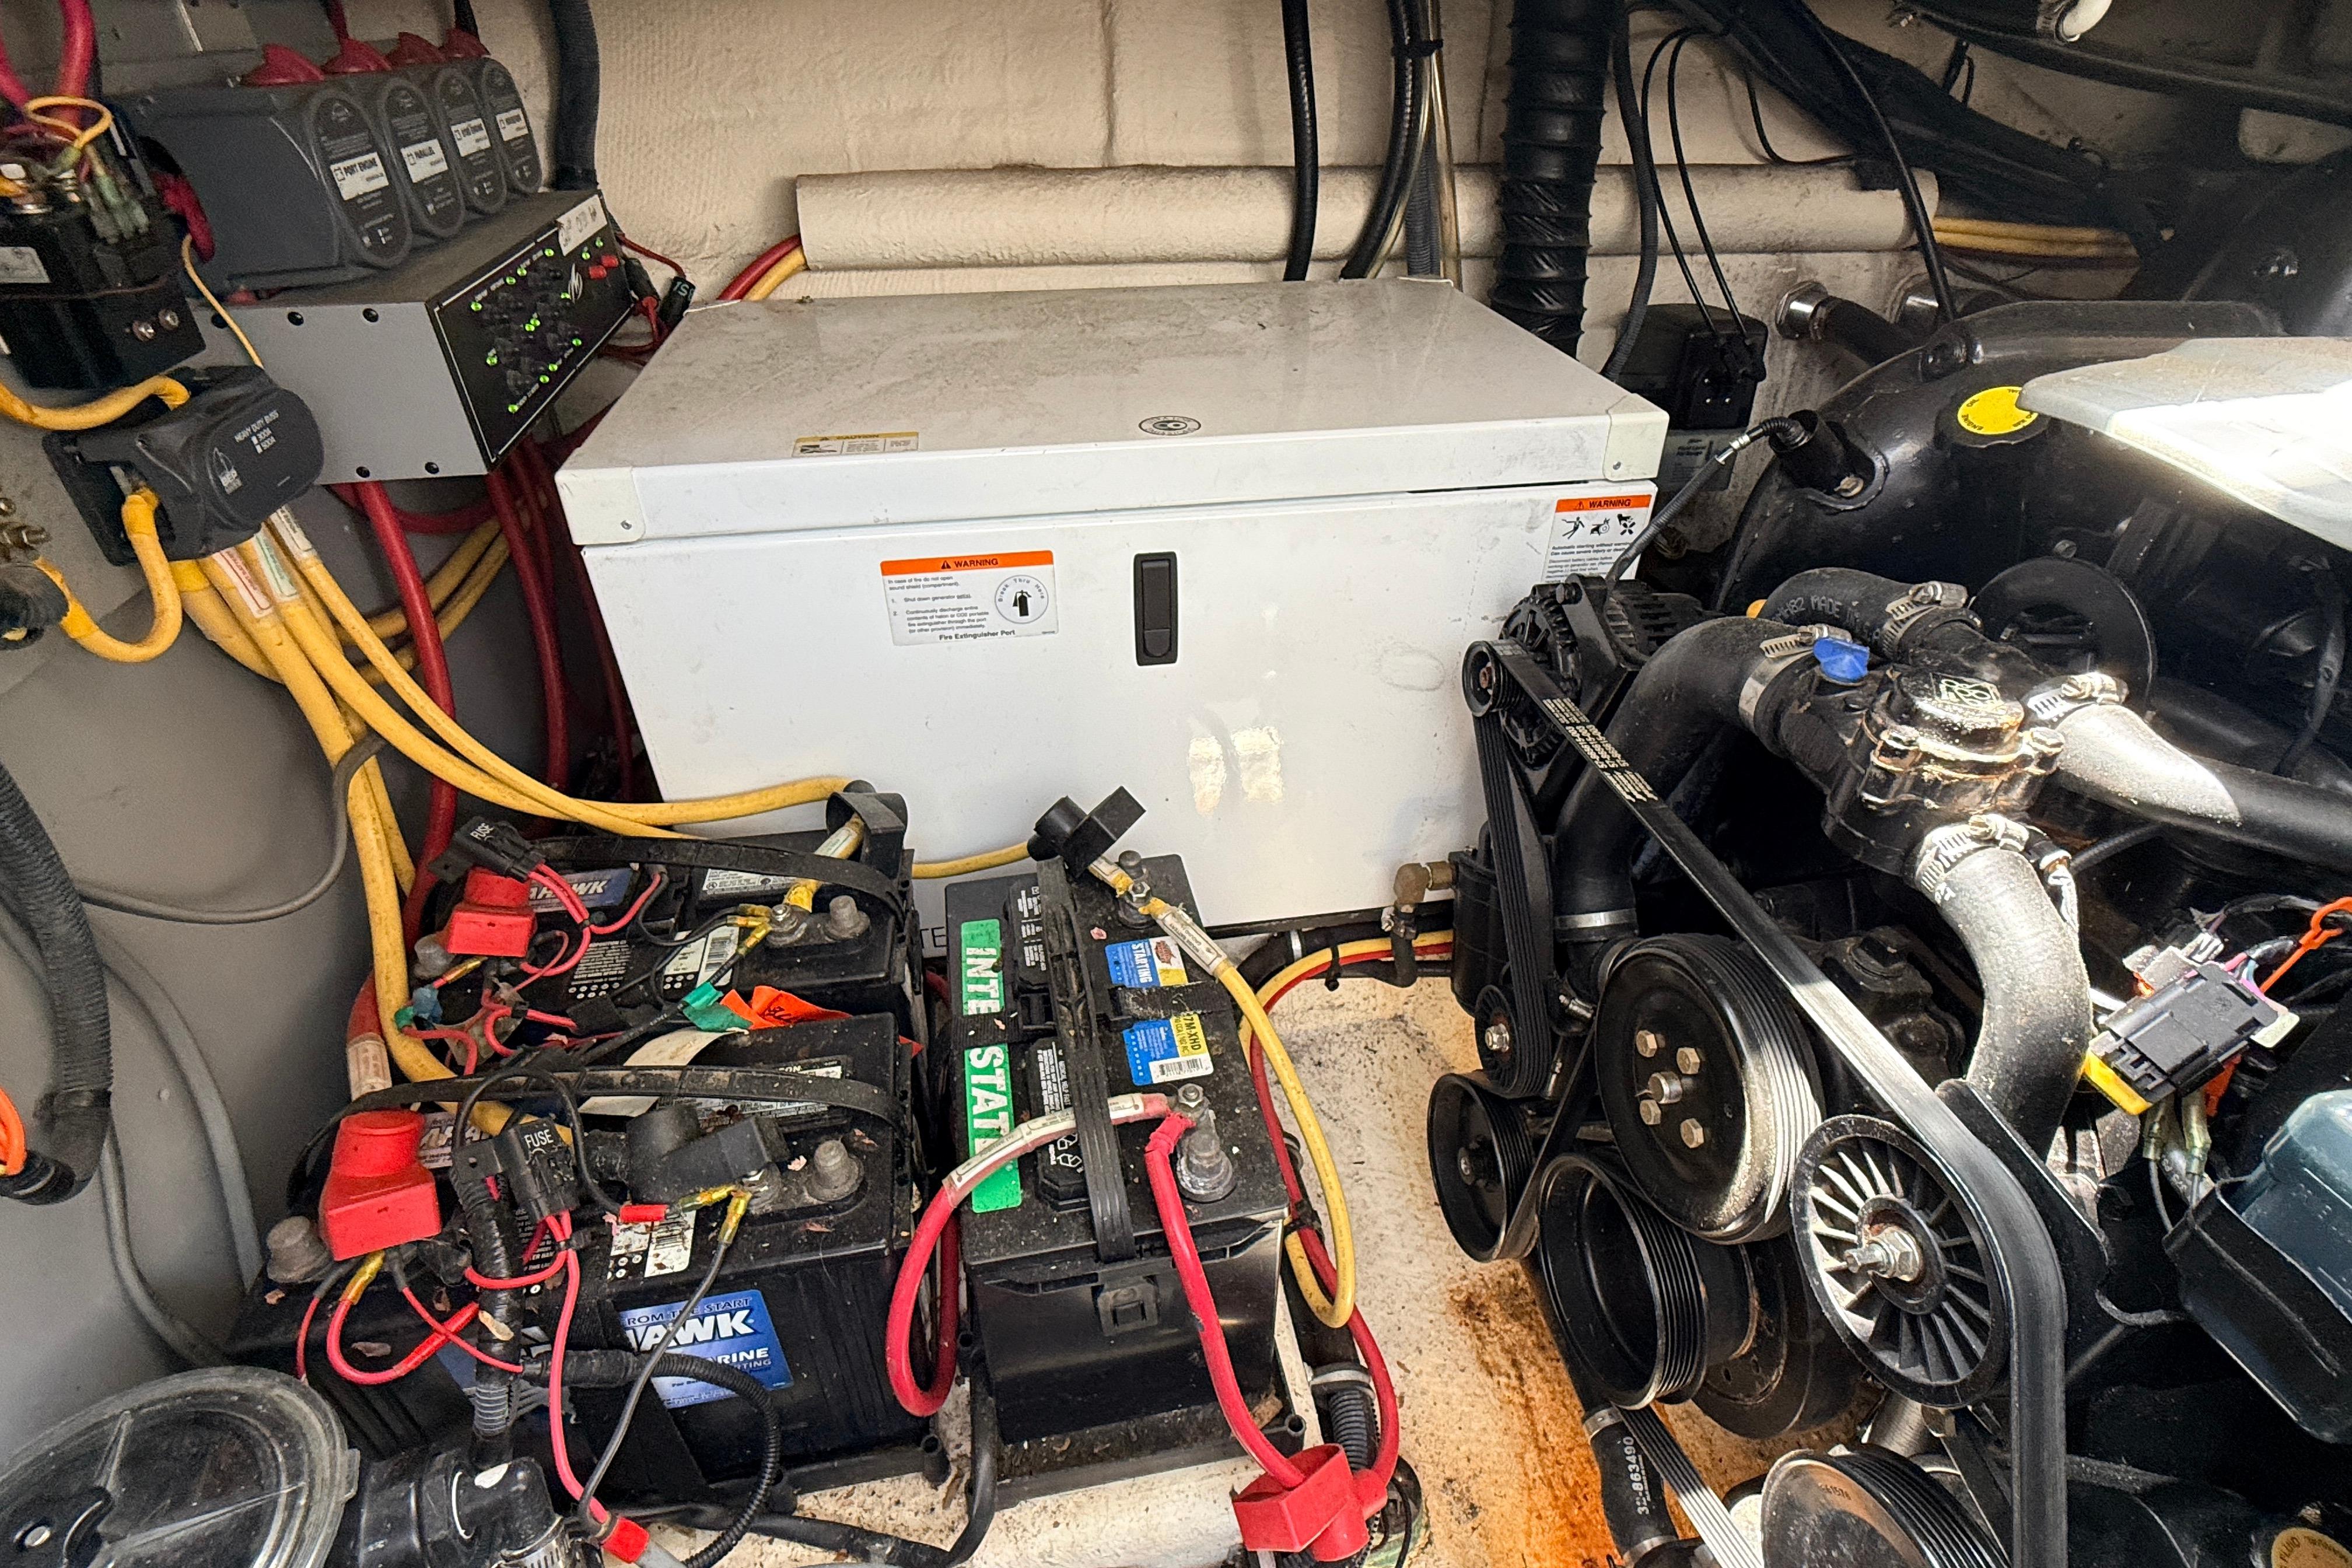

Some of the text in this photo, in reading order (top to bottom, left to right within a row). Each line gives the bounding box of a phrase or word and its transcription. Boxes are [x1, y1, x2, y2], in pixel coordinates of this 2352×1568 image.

[1966, 398, 1980, 407] OIL
[234, 426, 252, 443] HEAVY
[251, 418, 265, 433] DUTY
[1962, 414, 1984, 430] ENGINE
[1589, 498, 1632, 509] WARNING
[954, 558, 999, 568] WARNING
[1811, 594, 1843, 619] MADE
[954, 630, 999, 640] Extinguisher
[470, 822, 495, 841] FUSE
[1131, 943, 1153, 984] STARTING
[1183, 1016, 1202, 1051] 7M-XHD
[523, 1128, 554, 1149] FUSE
[627, 1312, 664, 1326] ROM
[704, 1297, 753, 1313] START
[2279, 1536, 2301, 1564] FLUID
